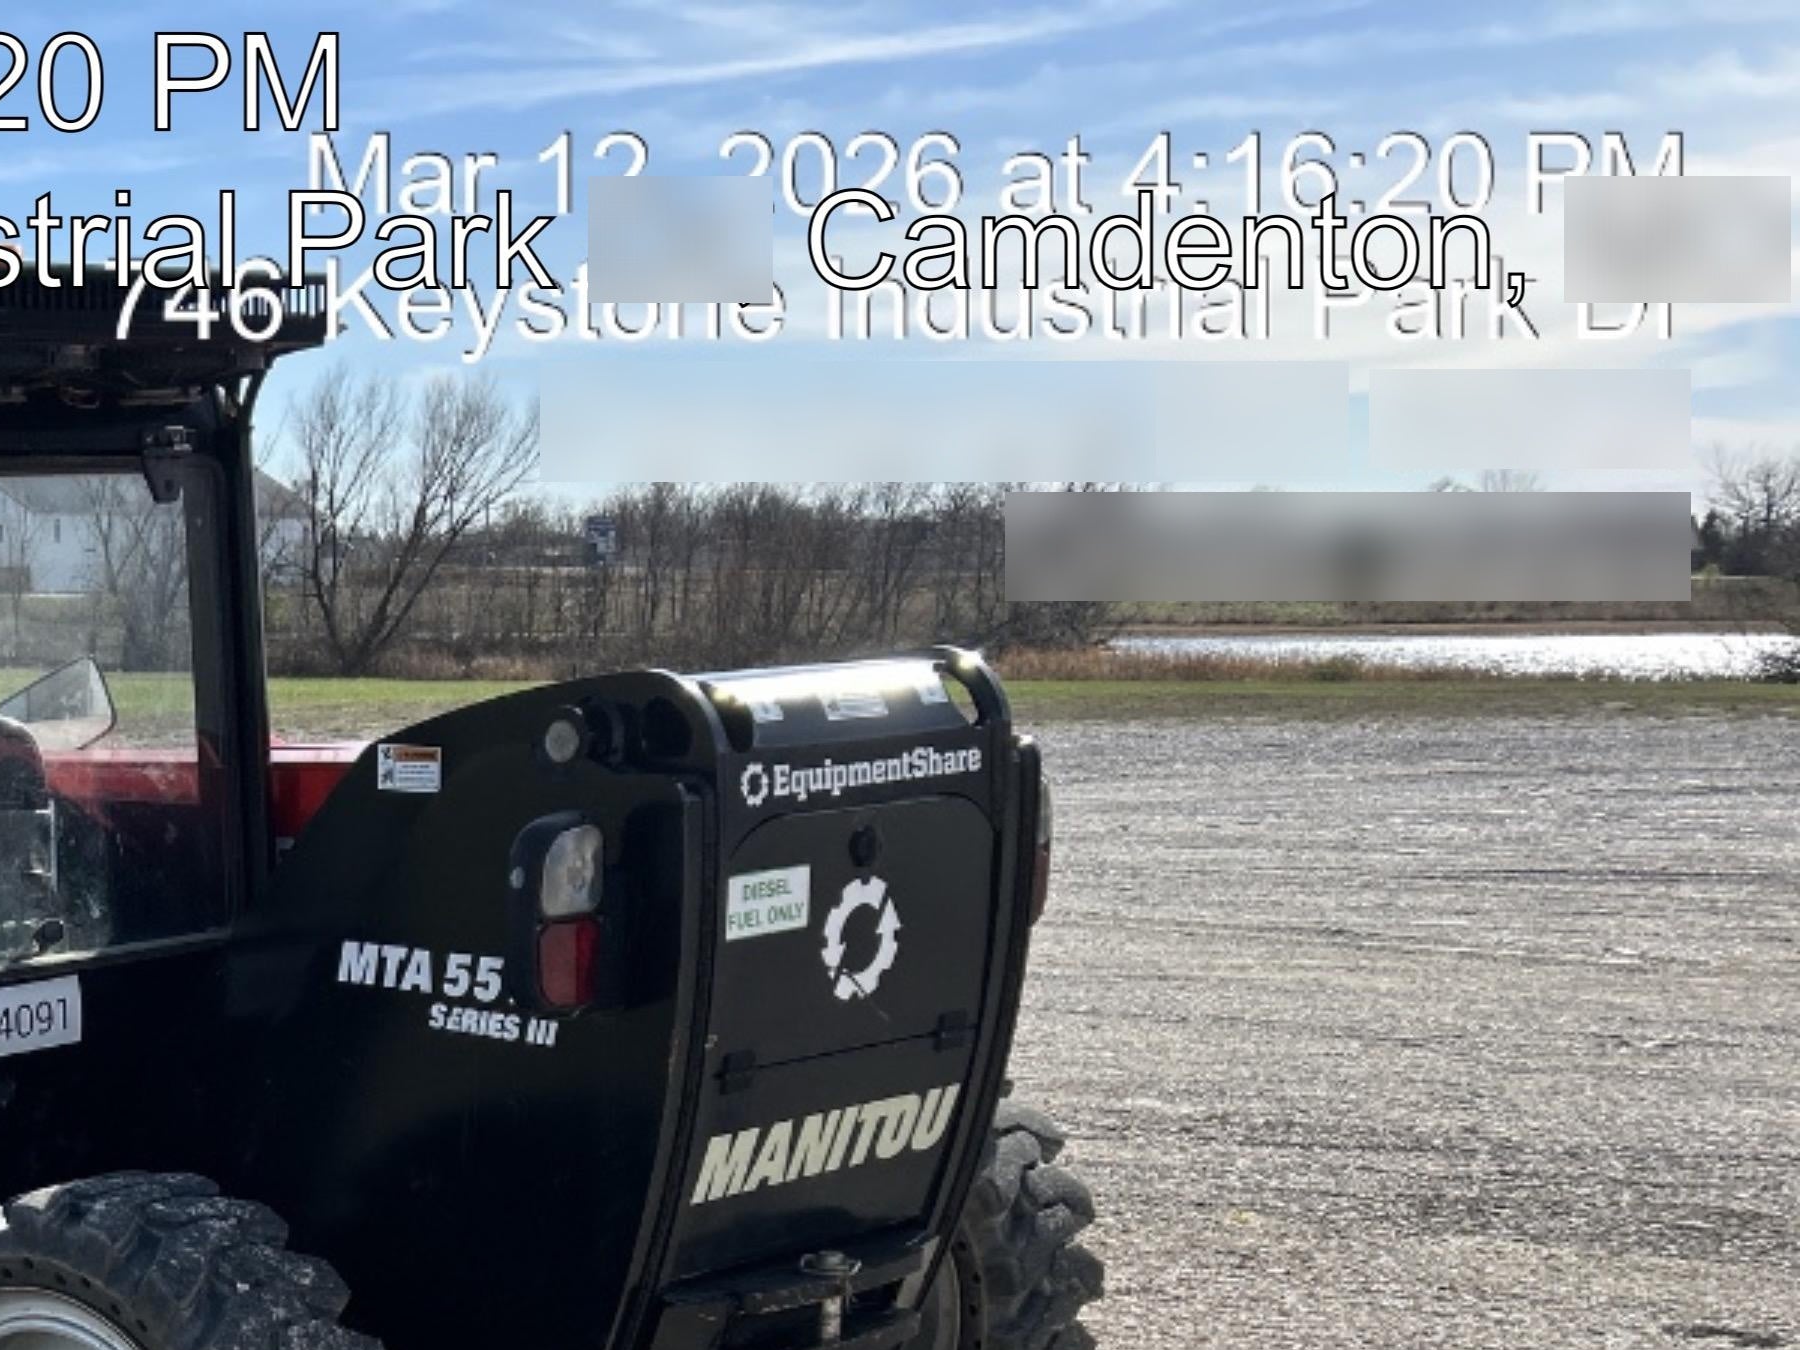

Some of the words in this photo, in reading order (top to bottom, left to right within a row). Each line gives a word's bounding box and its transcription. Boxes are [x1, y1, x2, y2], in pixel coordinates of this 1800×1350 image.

[773, 747, 983, 803] EquipmentShare
[743, 879, 793, 903] DIESEL
[728, 908, 762, 931] FUEL
[767, 901, 805, 925] ONLY
[337, 940, 433, 994] MTA
[443, 952, 506, 1003] 55
[428, 1001, 522, 1043] SERIES
[690, 1083, 962, 1207] MANITOU
